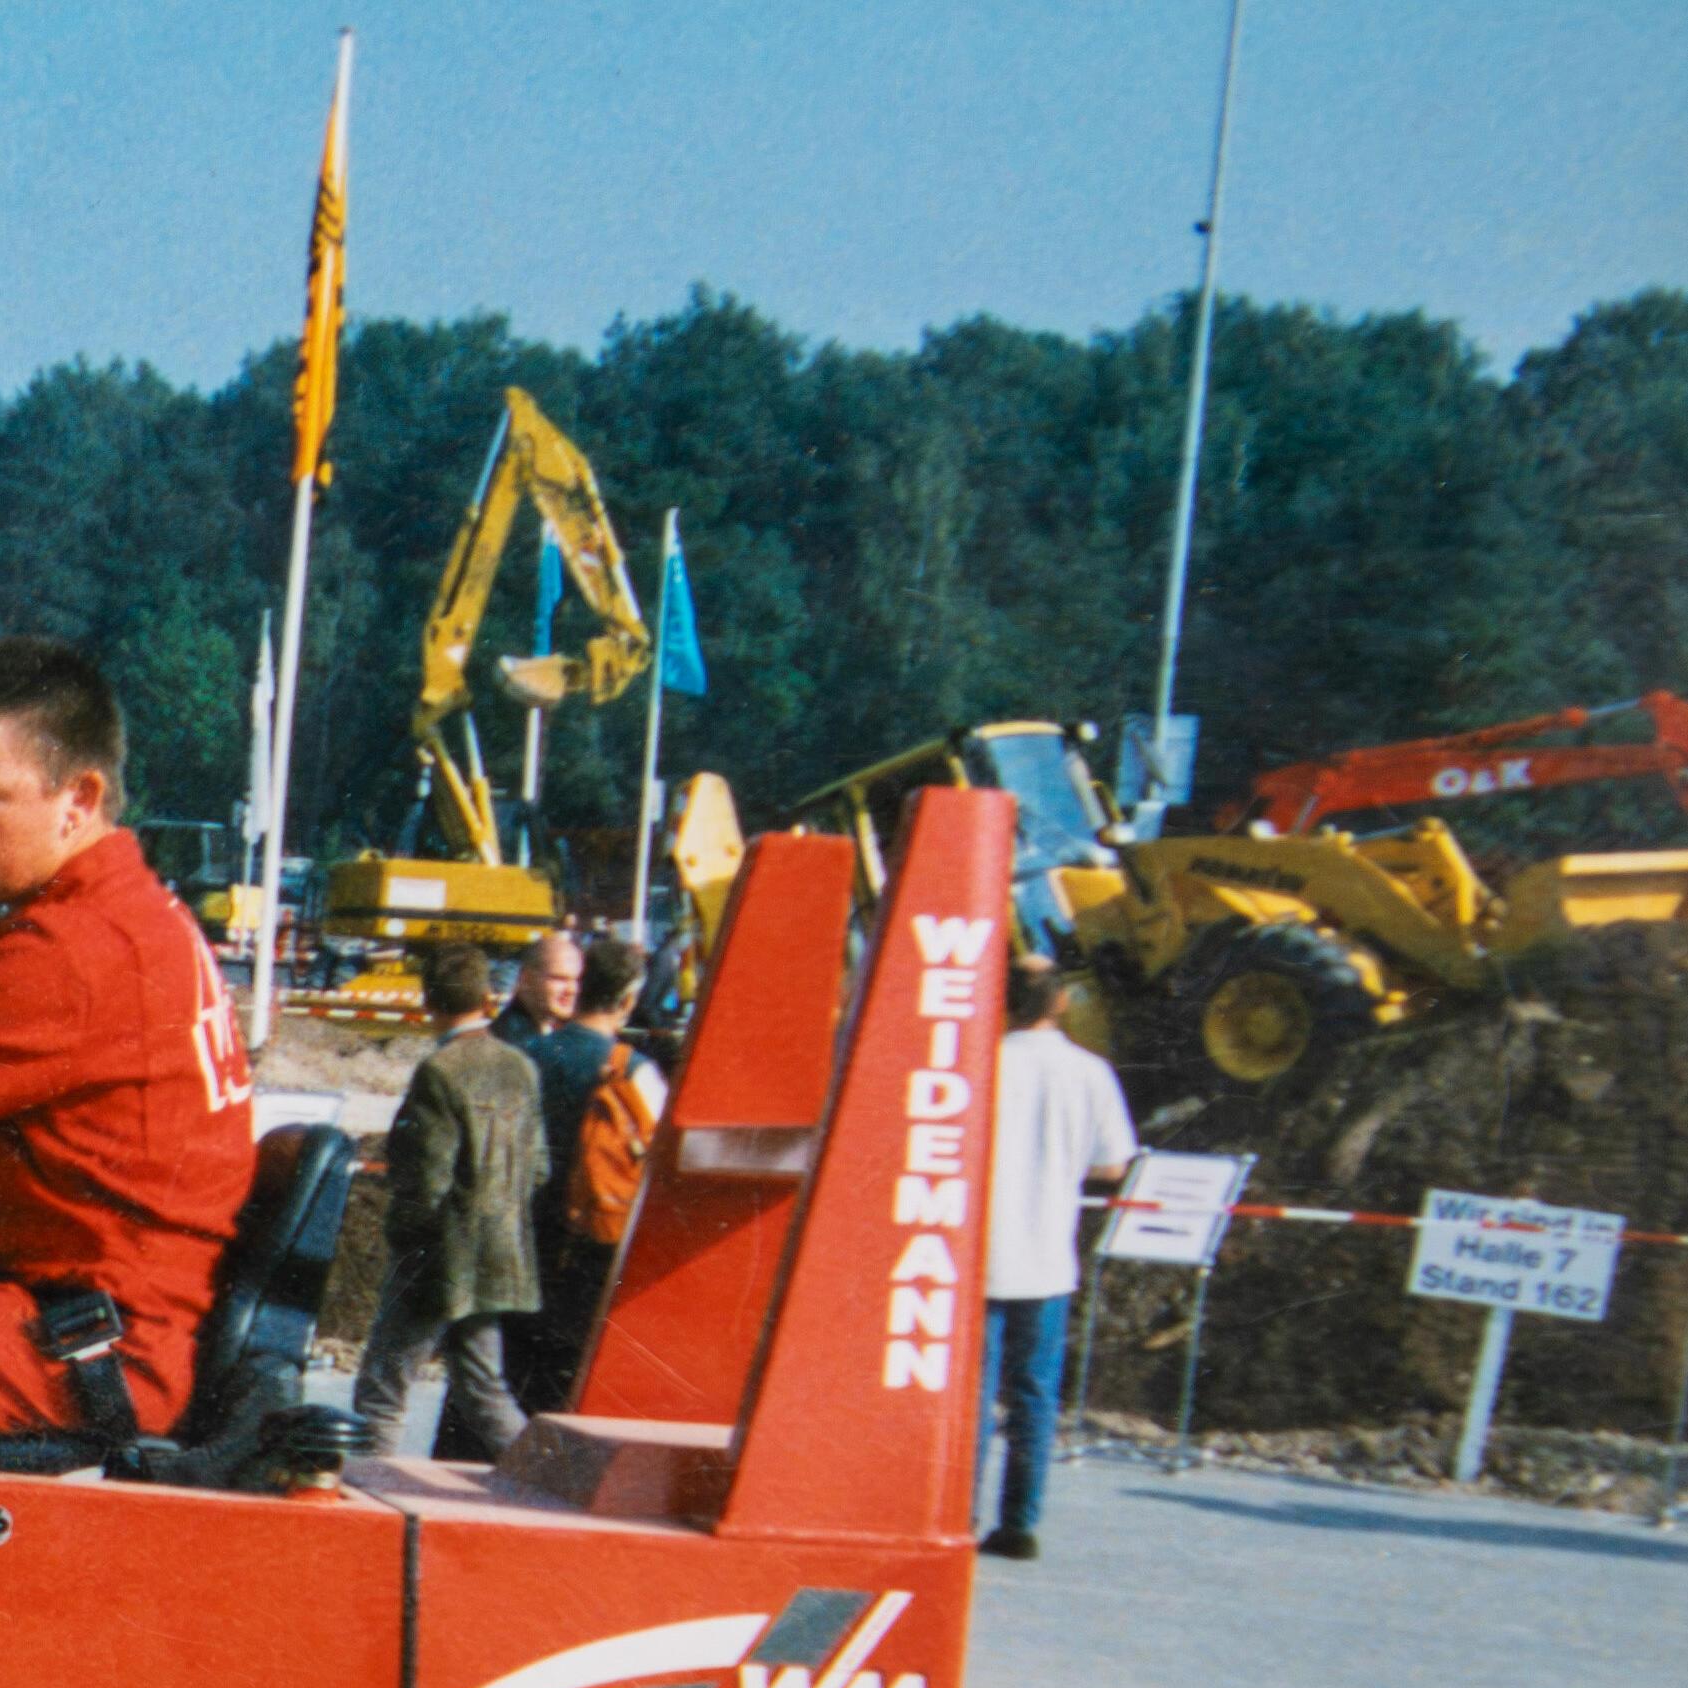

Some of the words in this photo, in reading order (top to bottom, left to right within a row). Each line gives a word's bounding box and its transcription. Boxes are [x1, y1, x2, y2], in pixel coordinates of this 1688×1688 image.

[1432, 757, 1533, 797] O&K
[882, 914, 994, 1392] WEIDEMANN
[1454, 1234, 1543, 1269] Halle
[1554, 1248, 1579, 1274] 7
[1421, 1263, 1520, 1300] Stand
[1536, 1281, 1600, 1314] 162
